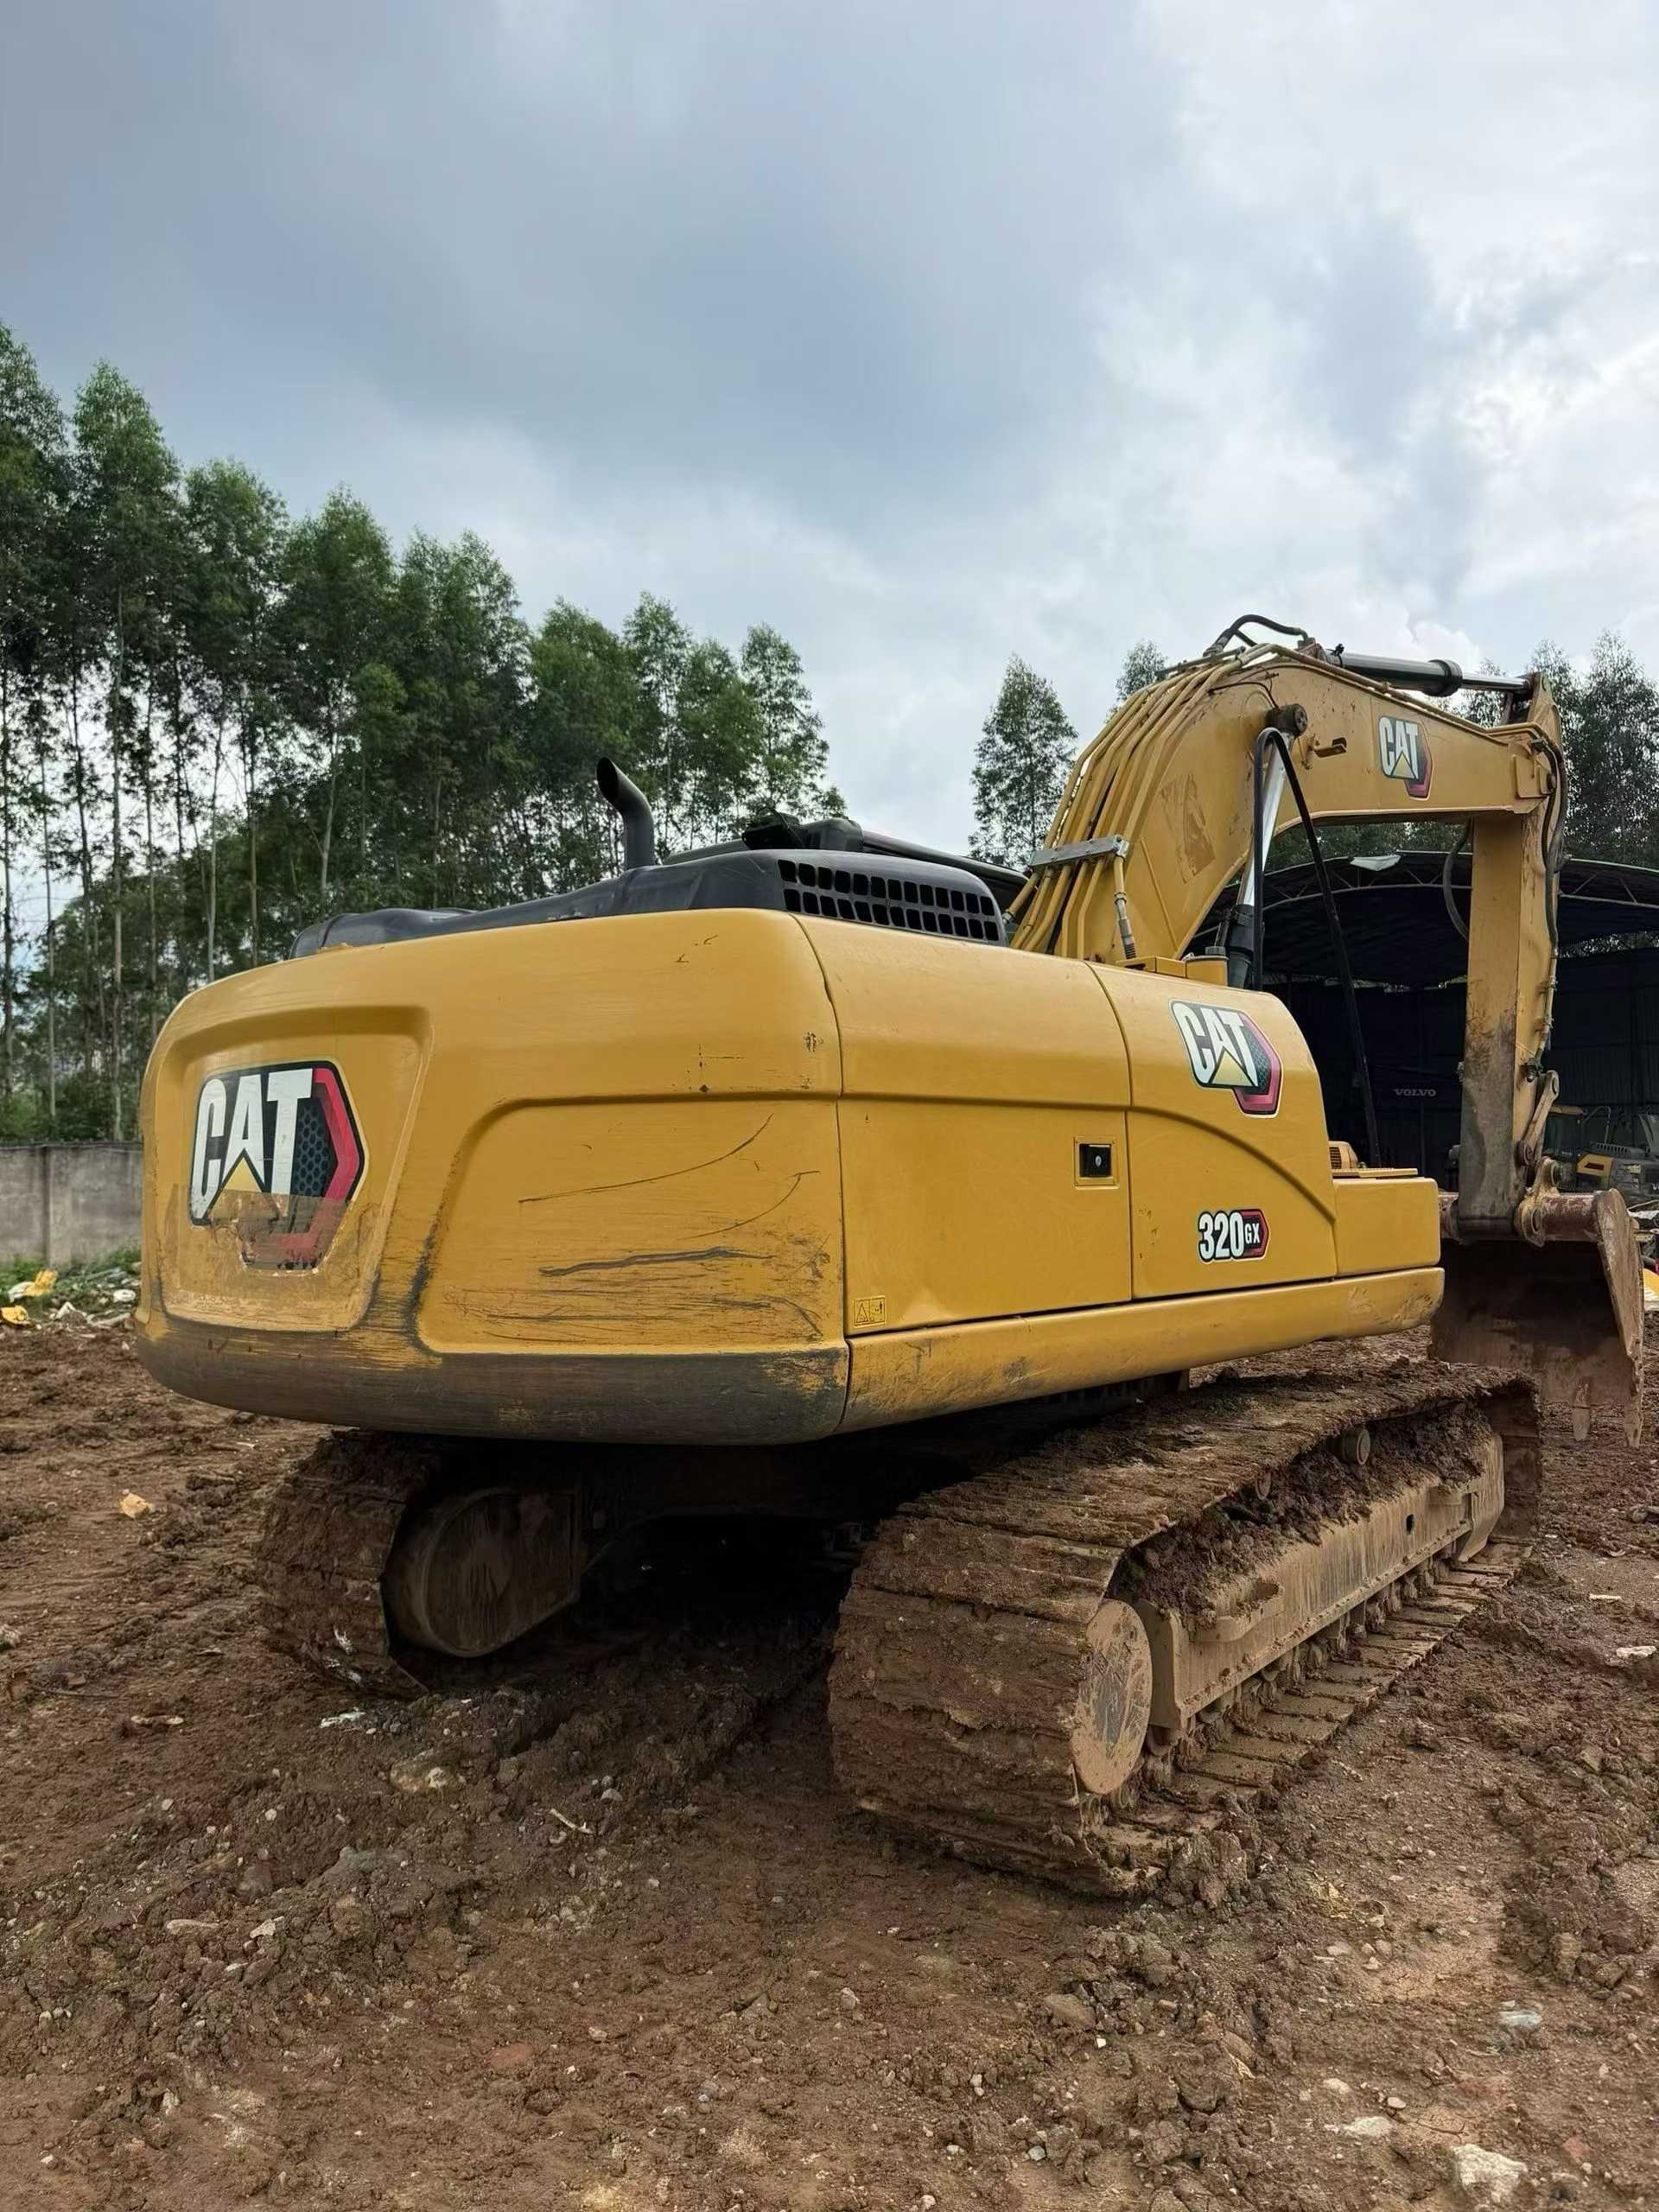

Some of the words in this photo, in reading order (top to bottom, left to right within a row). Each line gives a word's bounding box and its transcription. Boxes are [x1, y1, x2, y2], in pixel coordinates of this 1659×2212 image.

[1379, 717, 1419, 779] CAT
[1173, 1002, 1259, 1087] CAT
[192, 1068, 313, 1218] CAT
